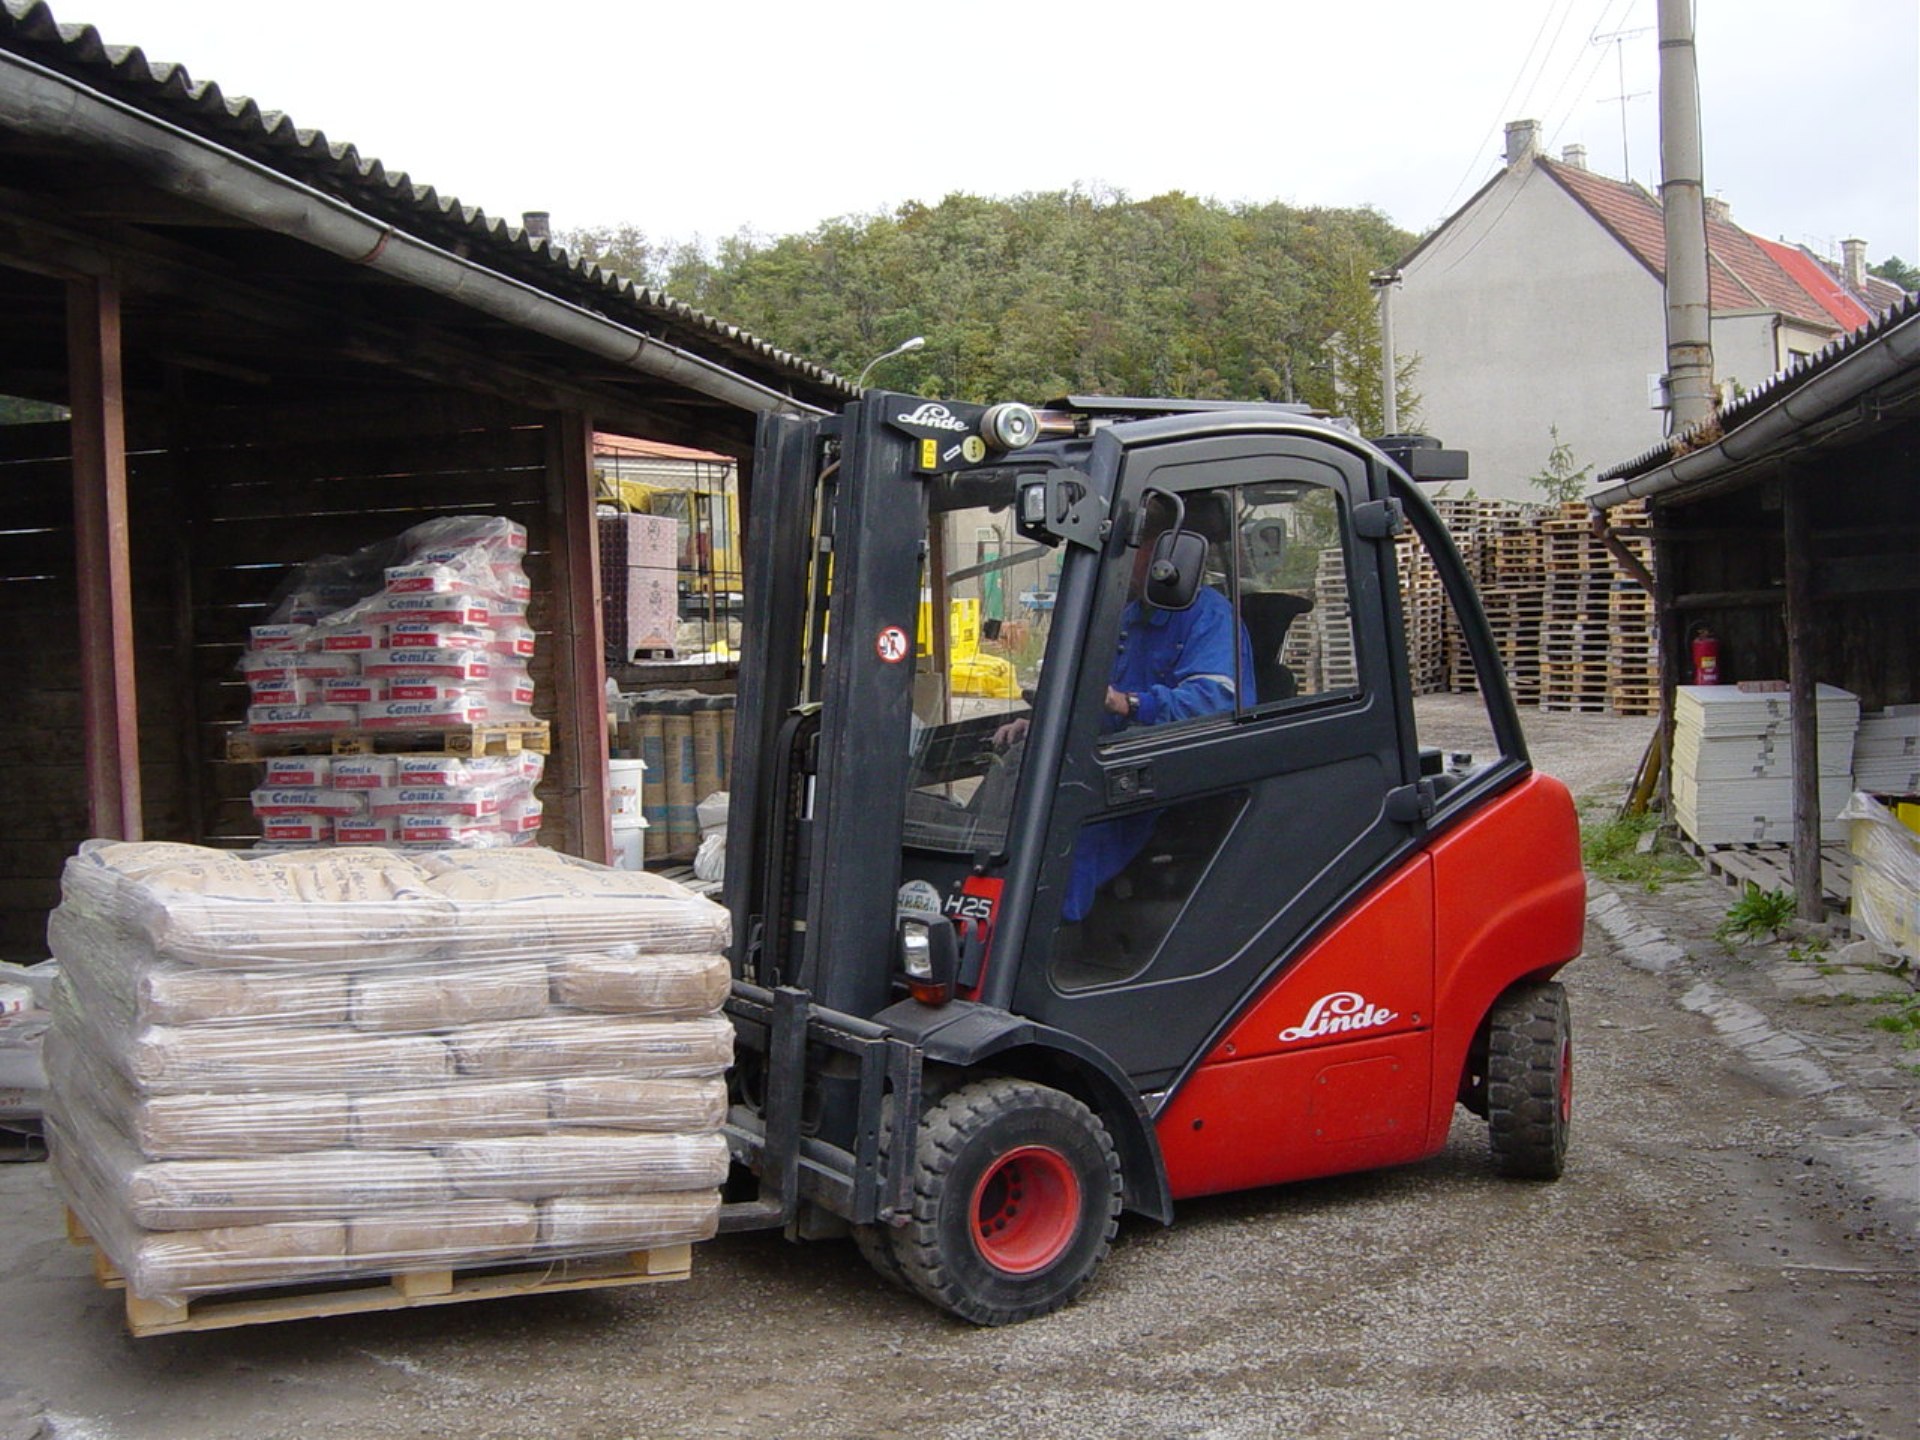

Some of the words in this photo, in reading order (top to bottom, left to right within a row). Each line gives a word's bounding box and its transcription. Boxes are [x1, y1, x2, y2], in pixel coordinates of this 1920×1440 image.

[897, 402, 969, 431] Linde
[396, 622, 429, 632] Cemix
[389, 650, 436, 663] Cemix
[386, 702, 432, 715] Cemix
[272, 791, 317, 804] Cemix
[944, 894, 993, 919] H25
[1278, 991, 1398, 1042] Linde
